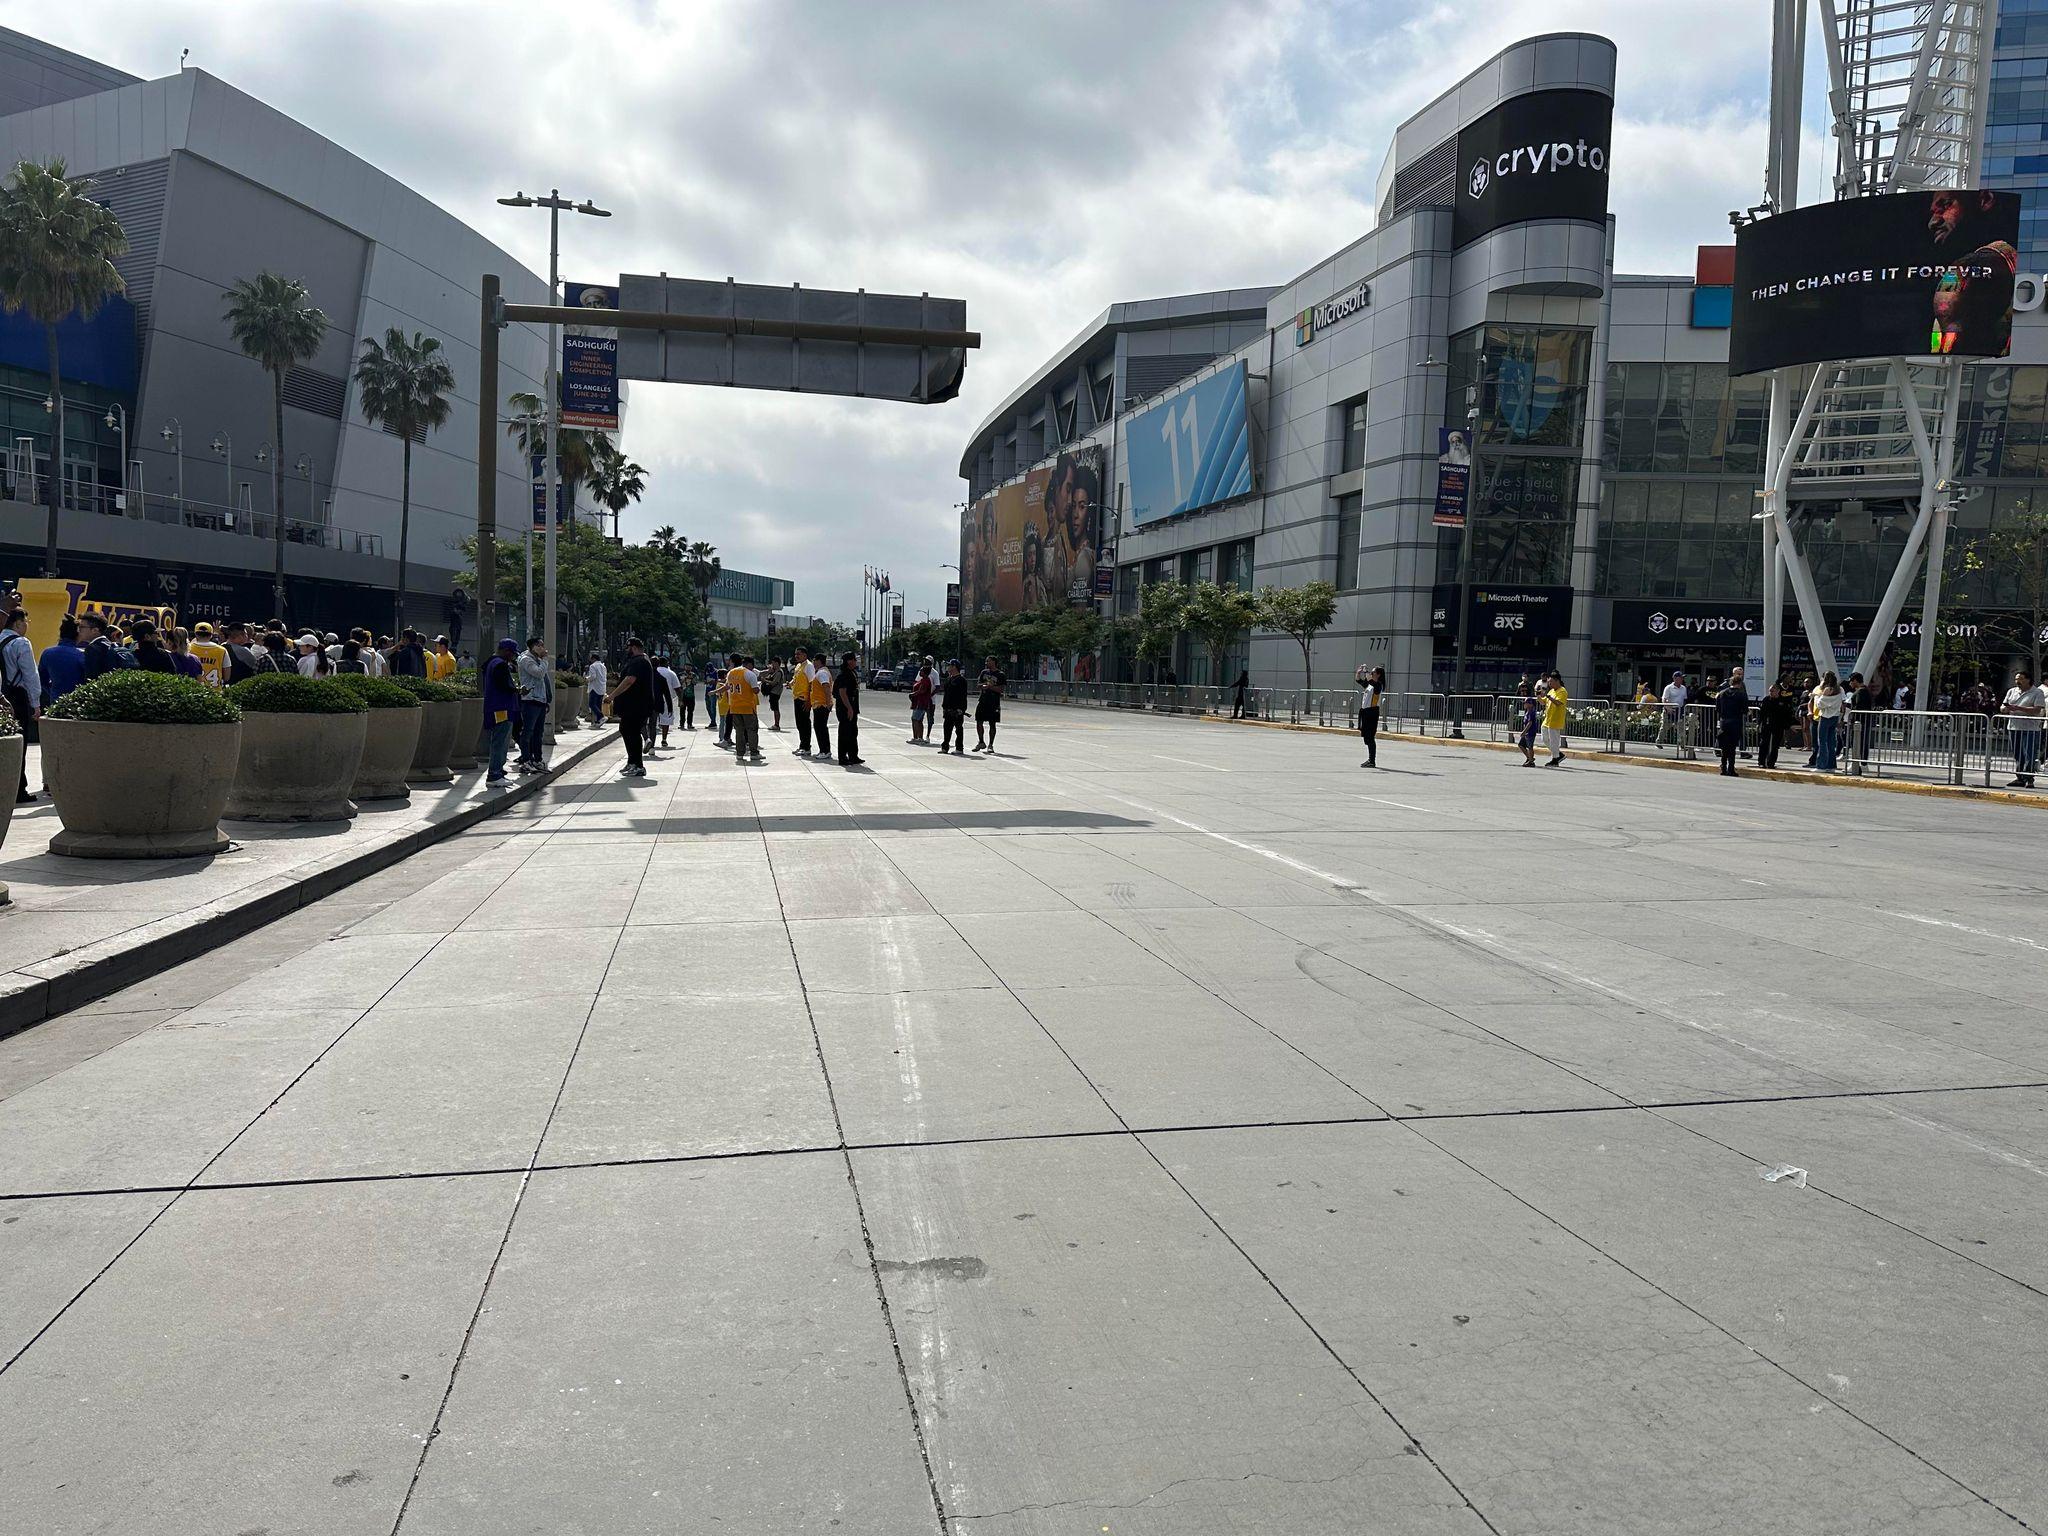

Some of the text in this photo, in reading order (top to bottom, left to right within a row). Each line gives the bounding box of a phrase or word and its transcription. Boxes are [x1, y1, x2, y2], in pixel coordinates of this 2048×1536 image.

[1751, 265, 1992, 301] THEN CHANGE IT FOREVER
[1313, 282, 1367, 331] Microsoft
[566, 339, 616, 351] SADHGURU
[569, 360, 613, 370] ENGINEERING
[580, 355, 601, 363] INNER
[570, 367, 612, 377] COMPLETION
[573, 390, 590, 398] JUNE
[582, 384, 612, 393] ANGELES
[1161, 394, 1201, 506] 11
[1484, 475, 1511, 487] Blue
[1493, 489, 1557, 503] Caliornia
[996, 552, 1023, 567] CHARLOTT
[1488, 593, 1549, 603] Microsoft Theater
[188, 603, 231, 616] OFFICE
[1494, 616, 1525, 631] axs
[1674, 616, 1753, 633] crypto.c
[1488, 643, 1508, 652] Office
